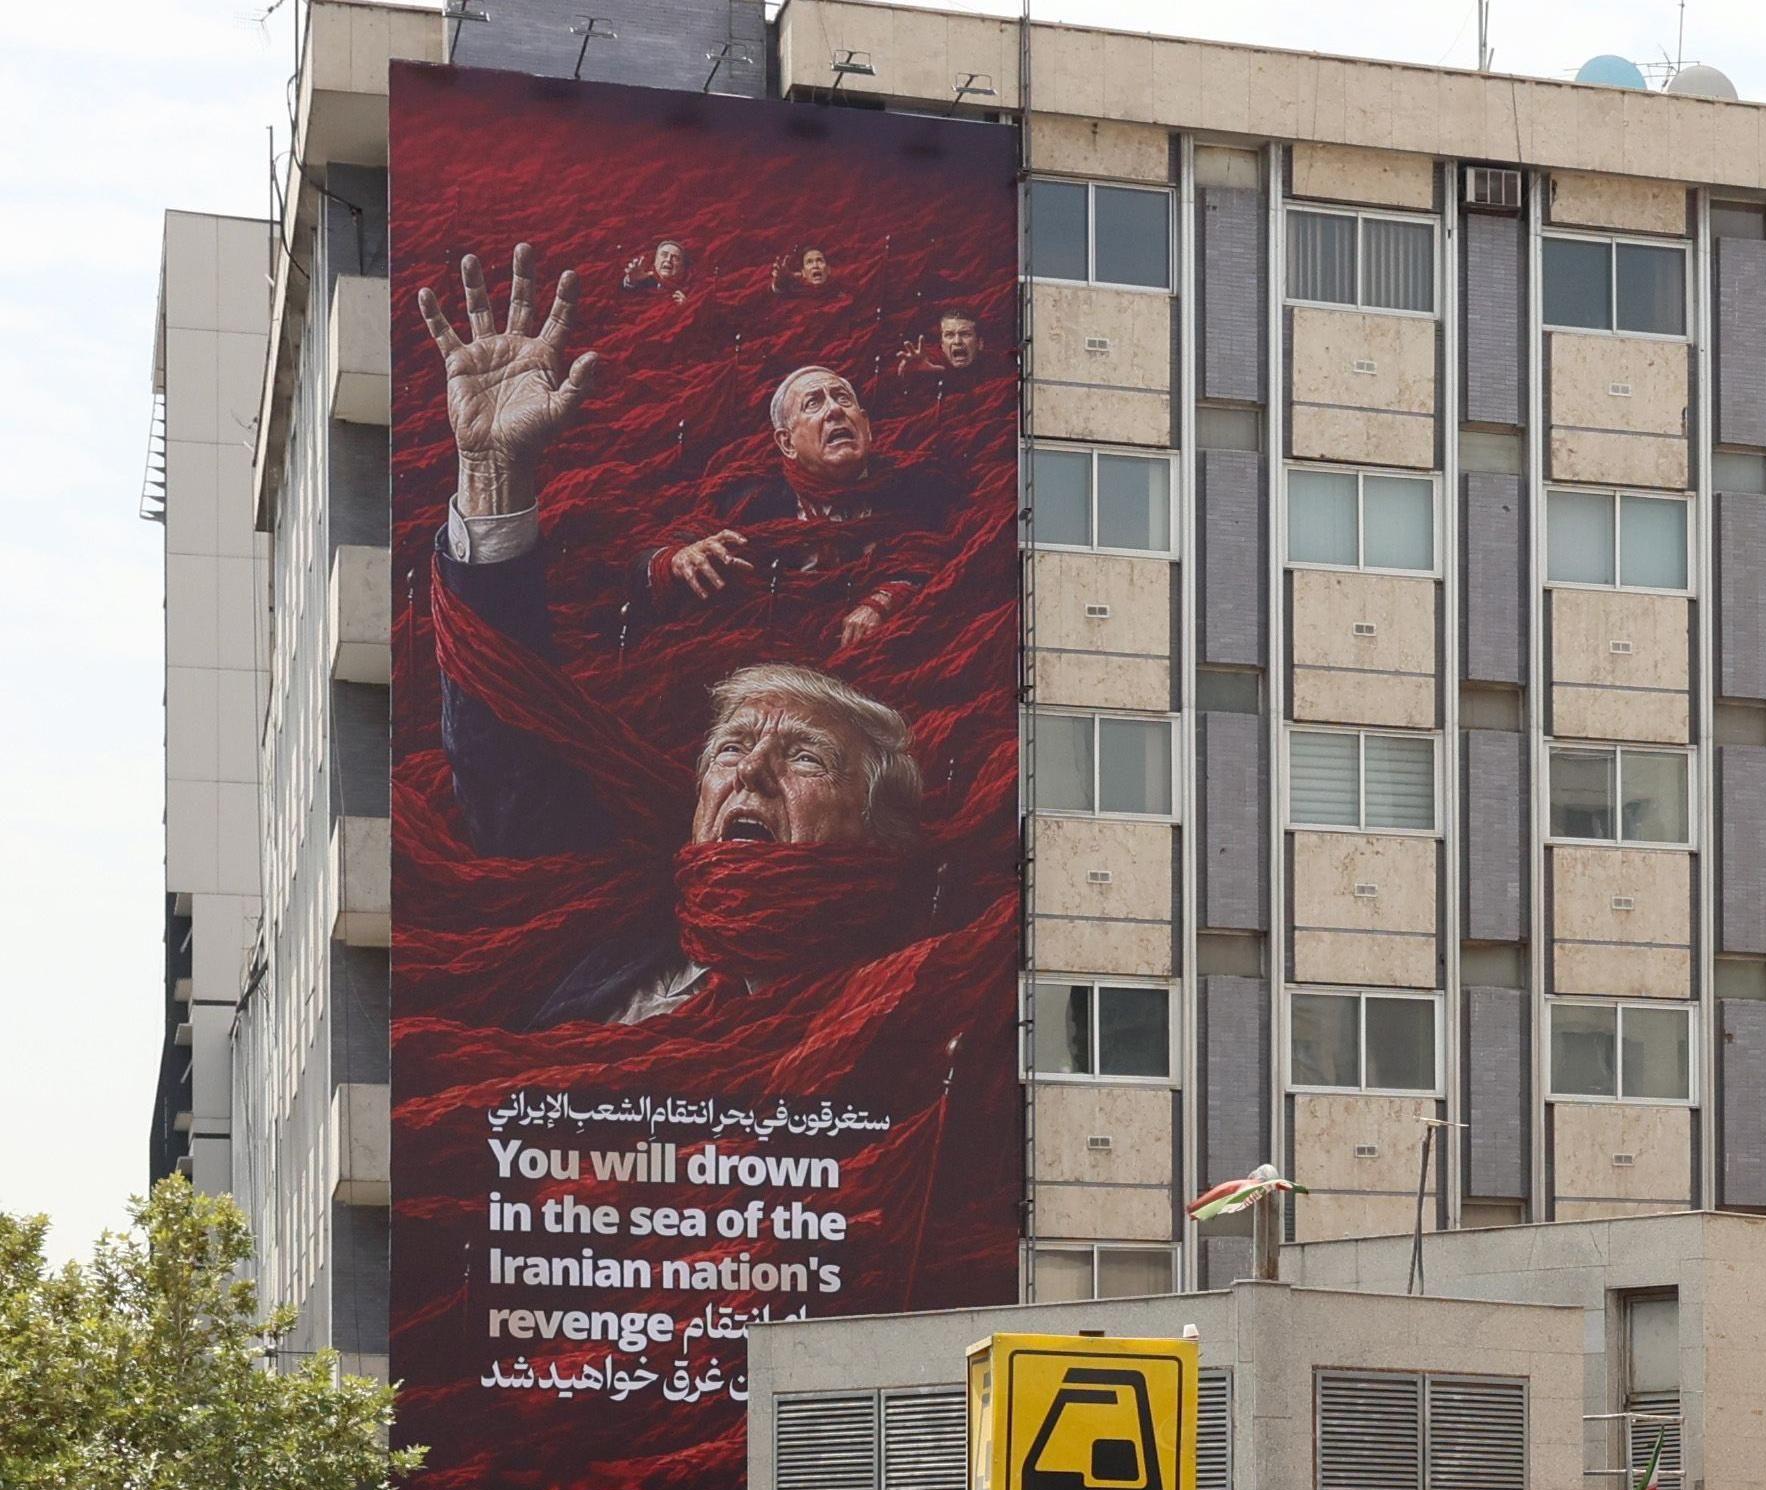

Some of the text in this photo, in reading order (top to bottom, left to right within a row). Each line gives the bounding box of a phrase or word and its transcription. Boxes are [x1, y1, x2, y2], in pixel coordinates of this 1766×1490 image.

[488, 1139, 839, 1188] You will drown
[489, 1192, 847, 1241] in the sea of the
[489, 1248, 841, 1293] Iranian nation's
[489, 1308, 674, 1352] revenge
[481, 1356, 535, 1388] شد
[538, 1354, 659, 1401] خواهید
[663, 1357, 725, 1402] غرق
